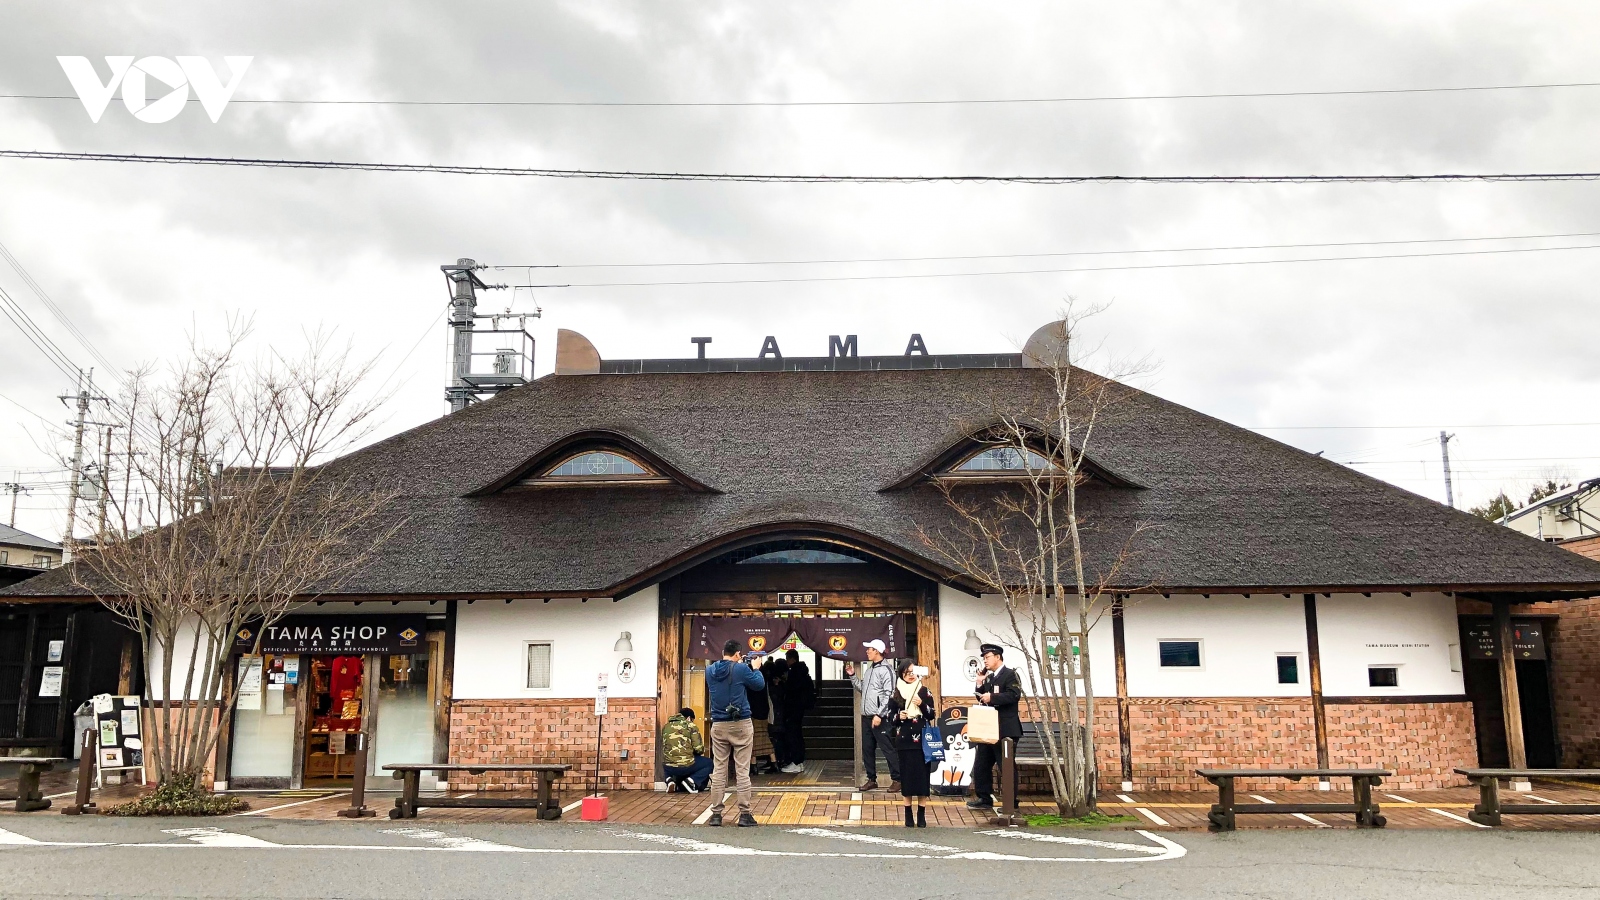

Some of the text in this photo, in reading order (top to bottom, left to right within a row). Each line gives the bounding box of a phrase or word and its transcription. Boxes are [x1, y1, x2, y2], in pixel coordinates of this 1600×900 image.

[690, 333, 929, 359] TAMA
[783, 594, 813, 604] 貴志駅
[267, 626, 388, 640] TAMA SHOP
